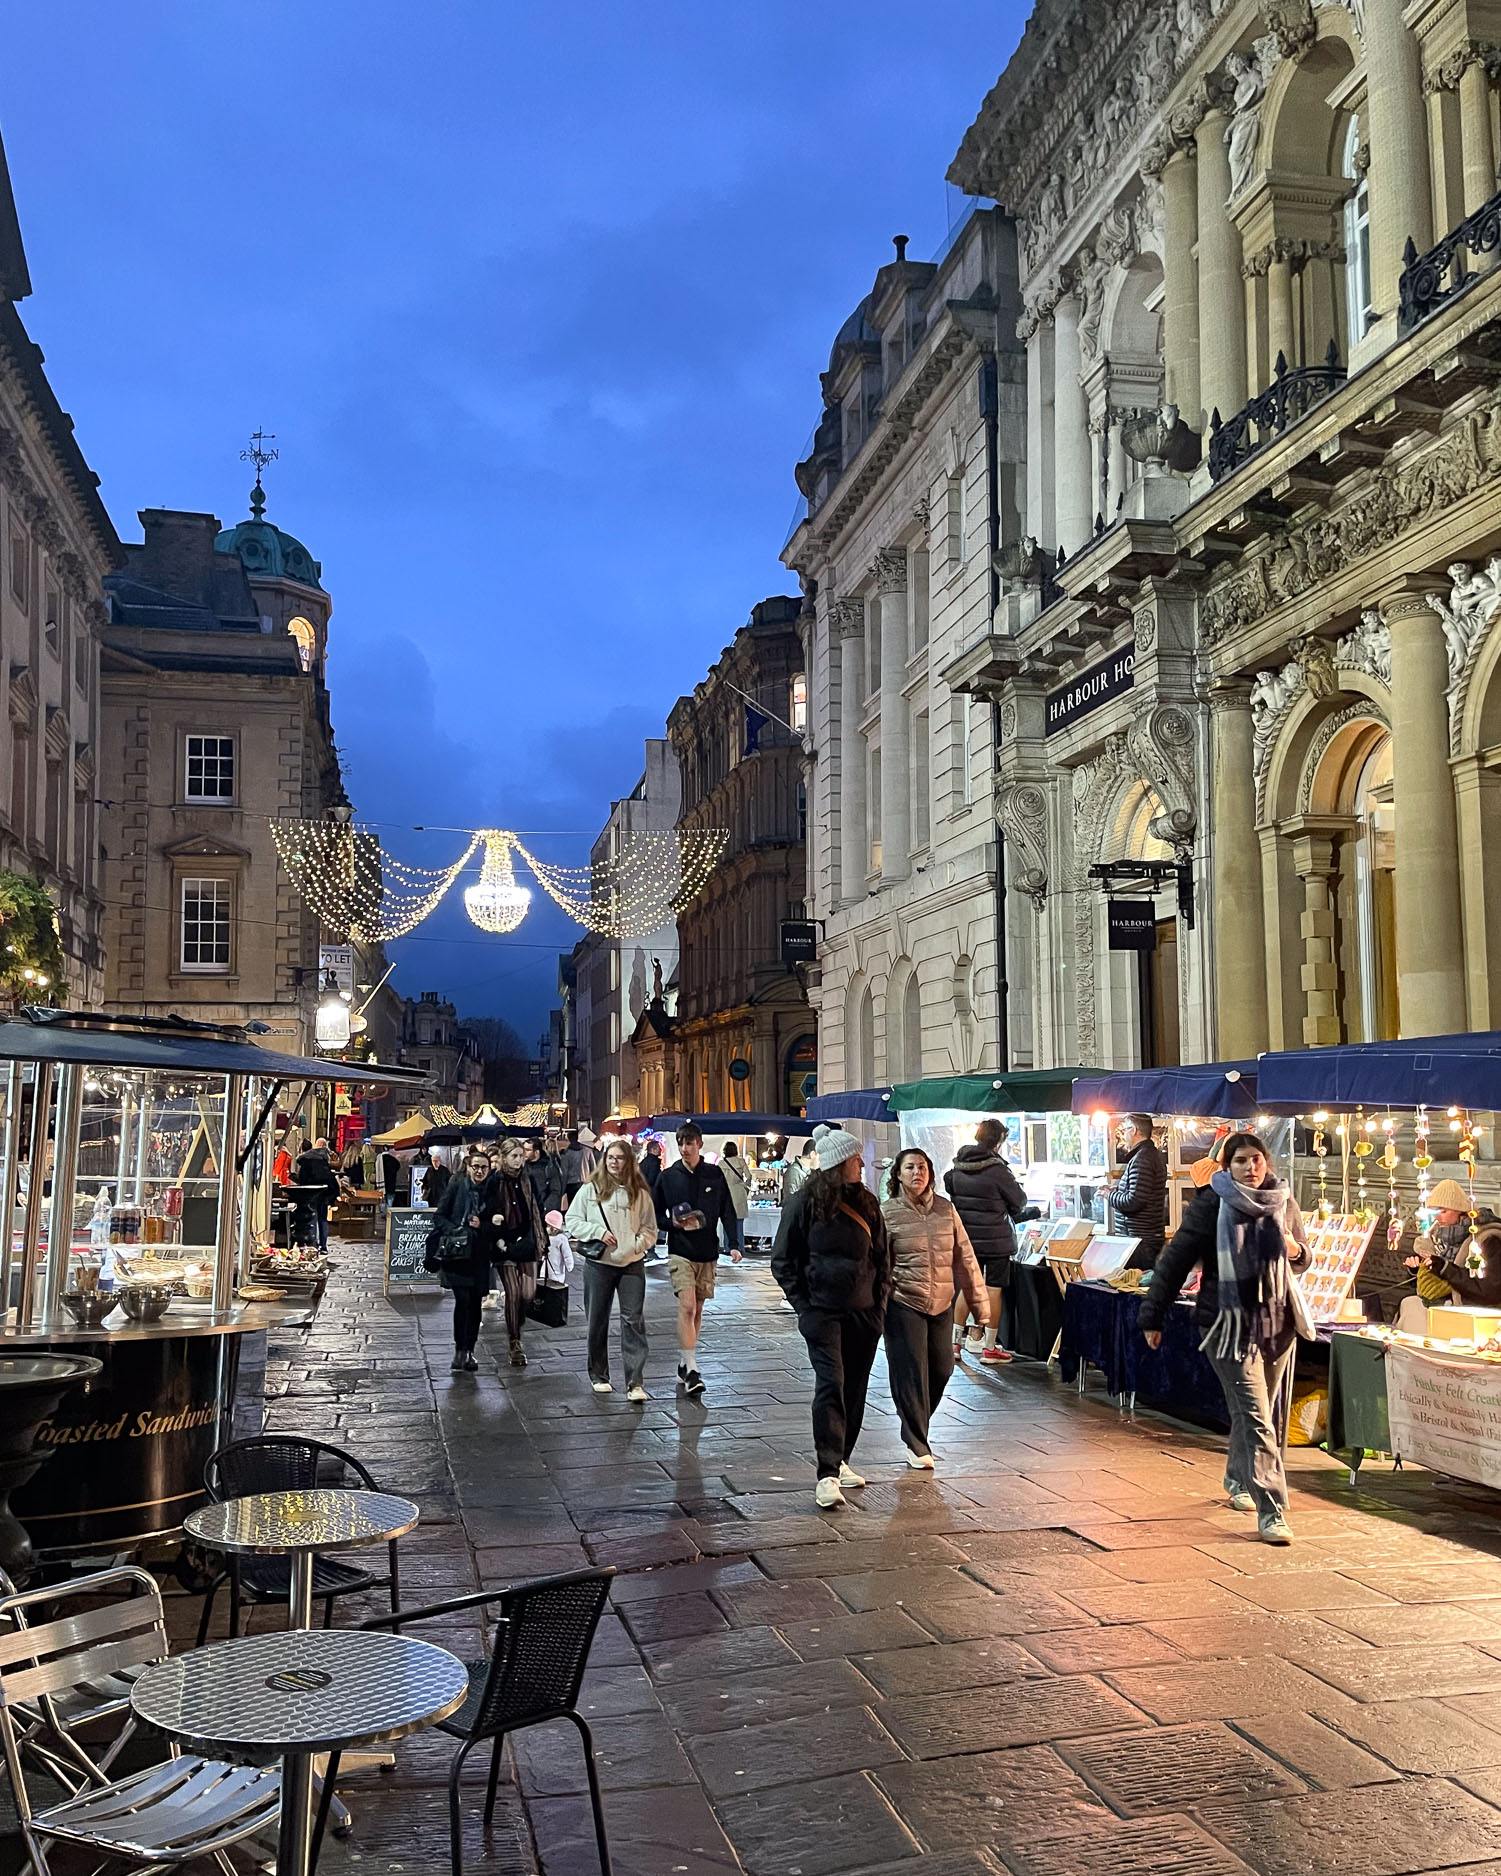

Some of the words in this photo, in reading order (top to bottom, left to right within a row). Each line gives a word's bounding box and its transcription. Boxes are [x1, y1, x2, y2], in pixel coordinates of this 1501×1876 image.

[1050, 672, 1109, 722] HARBOUR
[1114, 655, 1134, 683] HO
[1111, 919, 1153, 927] HARBOUR
[334, 954, 351, 964] LET
[390, 1257, 414, 1267] CAKES
[1399, 1389, 1432, 1408] Ethically
[1445, 1383, 1464, 1400] Felt
[1420, 1411, 1449, 1428] Bristol
[1450, 1419, 1460, 1431] &
[1460, 1421, 1485, 1437] Nepal
